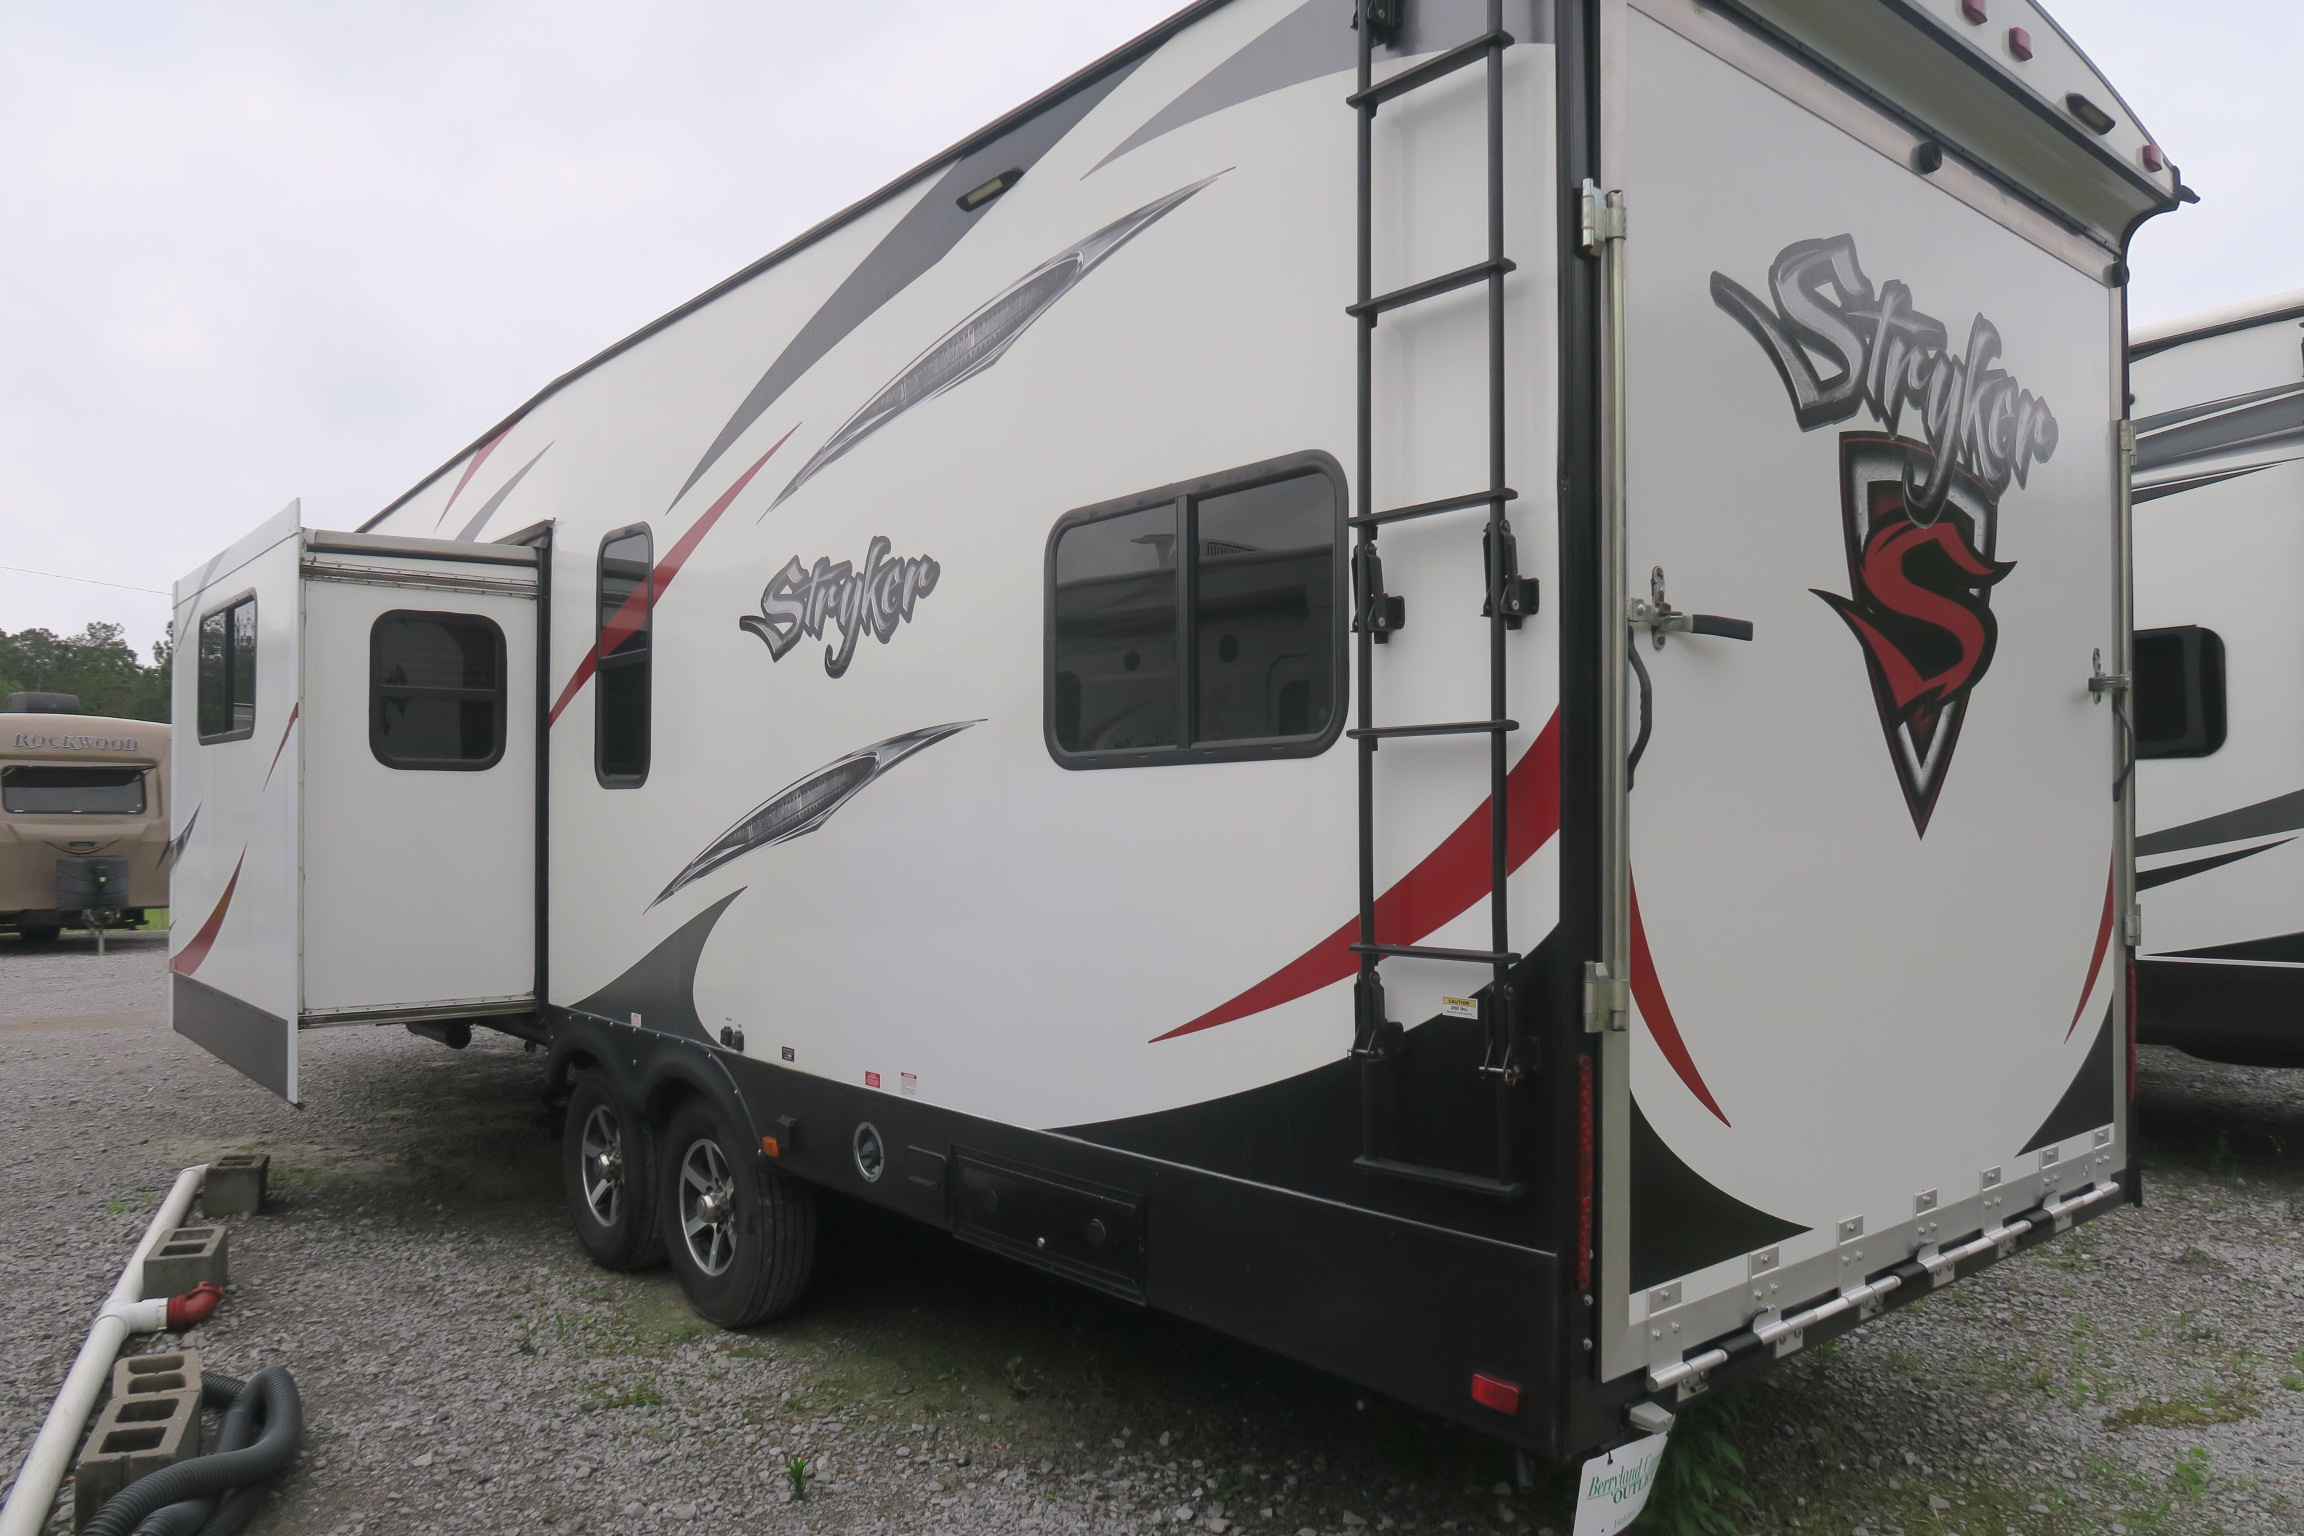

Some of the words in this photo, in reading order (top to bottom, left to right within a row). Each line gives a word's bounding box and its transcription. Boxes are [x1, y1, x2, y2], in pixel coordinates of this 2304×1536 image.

[1710, 233, 2059, 529] Stryker
[739, 535, 941, 679] Stryker
[12, 732, 138, 751] ROCKWOOD
[1448, 998, 1470, 1006] CAUTION
[1588, 1458, 1643, 1497] Berryland
